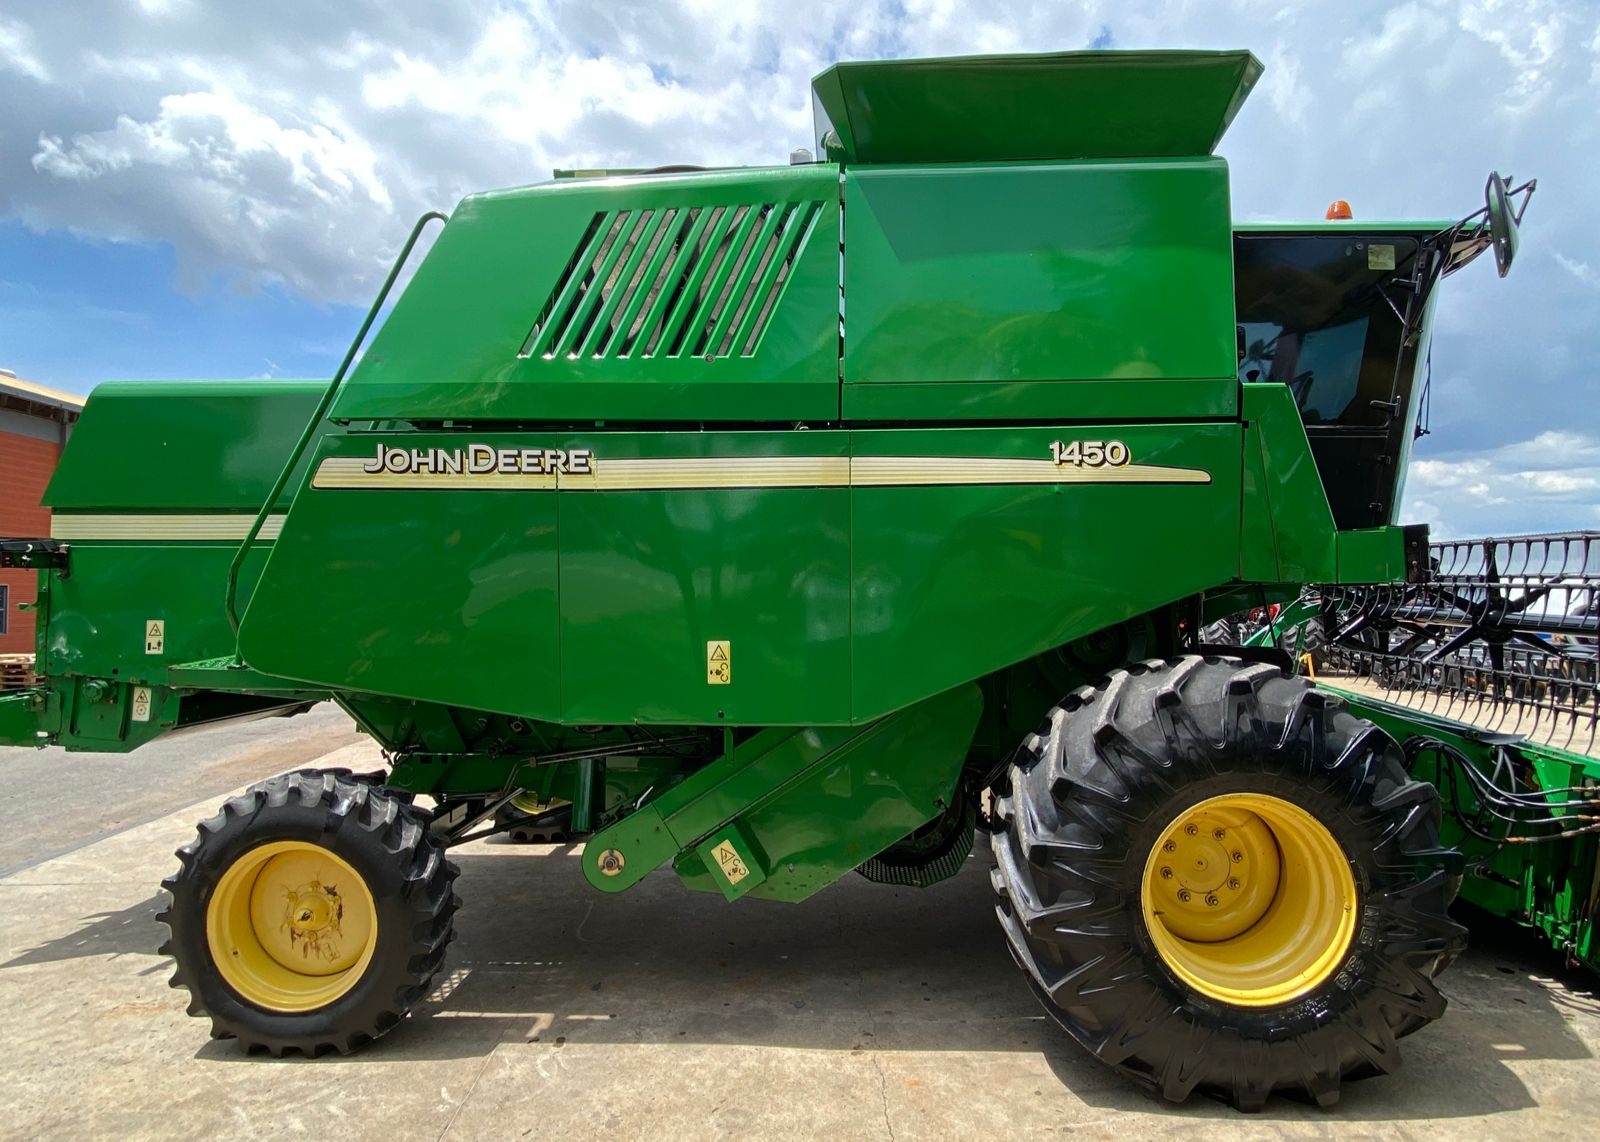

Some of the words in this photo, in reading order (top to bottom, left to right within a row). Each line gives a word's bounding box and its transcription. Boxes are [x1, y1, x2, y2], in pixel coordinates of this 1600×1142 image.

[364, 443, 465, 475] JOHN
[466, 443, 593, 475] DEERE
[1049, 440, 1130, 468] 1450
